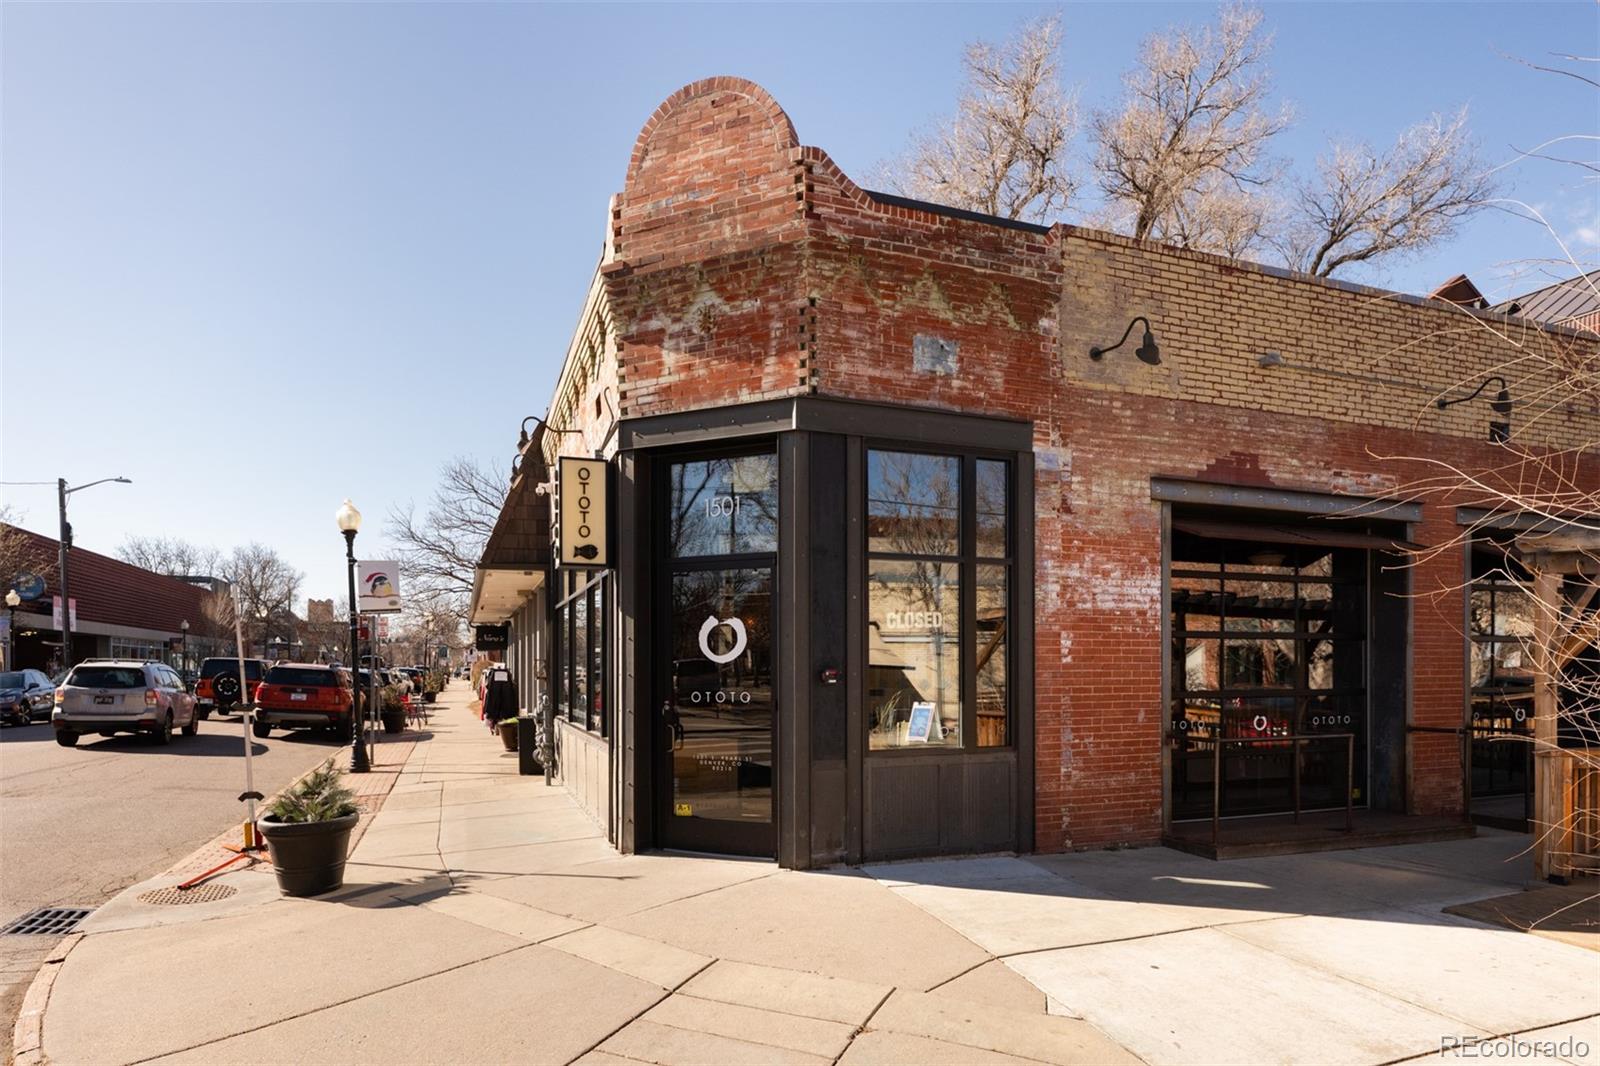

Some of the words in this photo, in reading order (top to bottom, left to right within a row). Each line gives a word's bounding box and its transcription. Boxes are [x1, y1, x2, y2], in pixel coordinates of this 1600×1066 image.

[578, 467, 591, 538] OTOTO
[704, 495, 741, 517] 1501
[886, 611, 943, 629] CLOSED
[690, 690, 752, 704] OTOTO
[1172, 720, 1205, 730] TOTO
[1312, 715, 1351, 726] OTOTO
